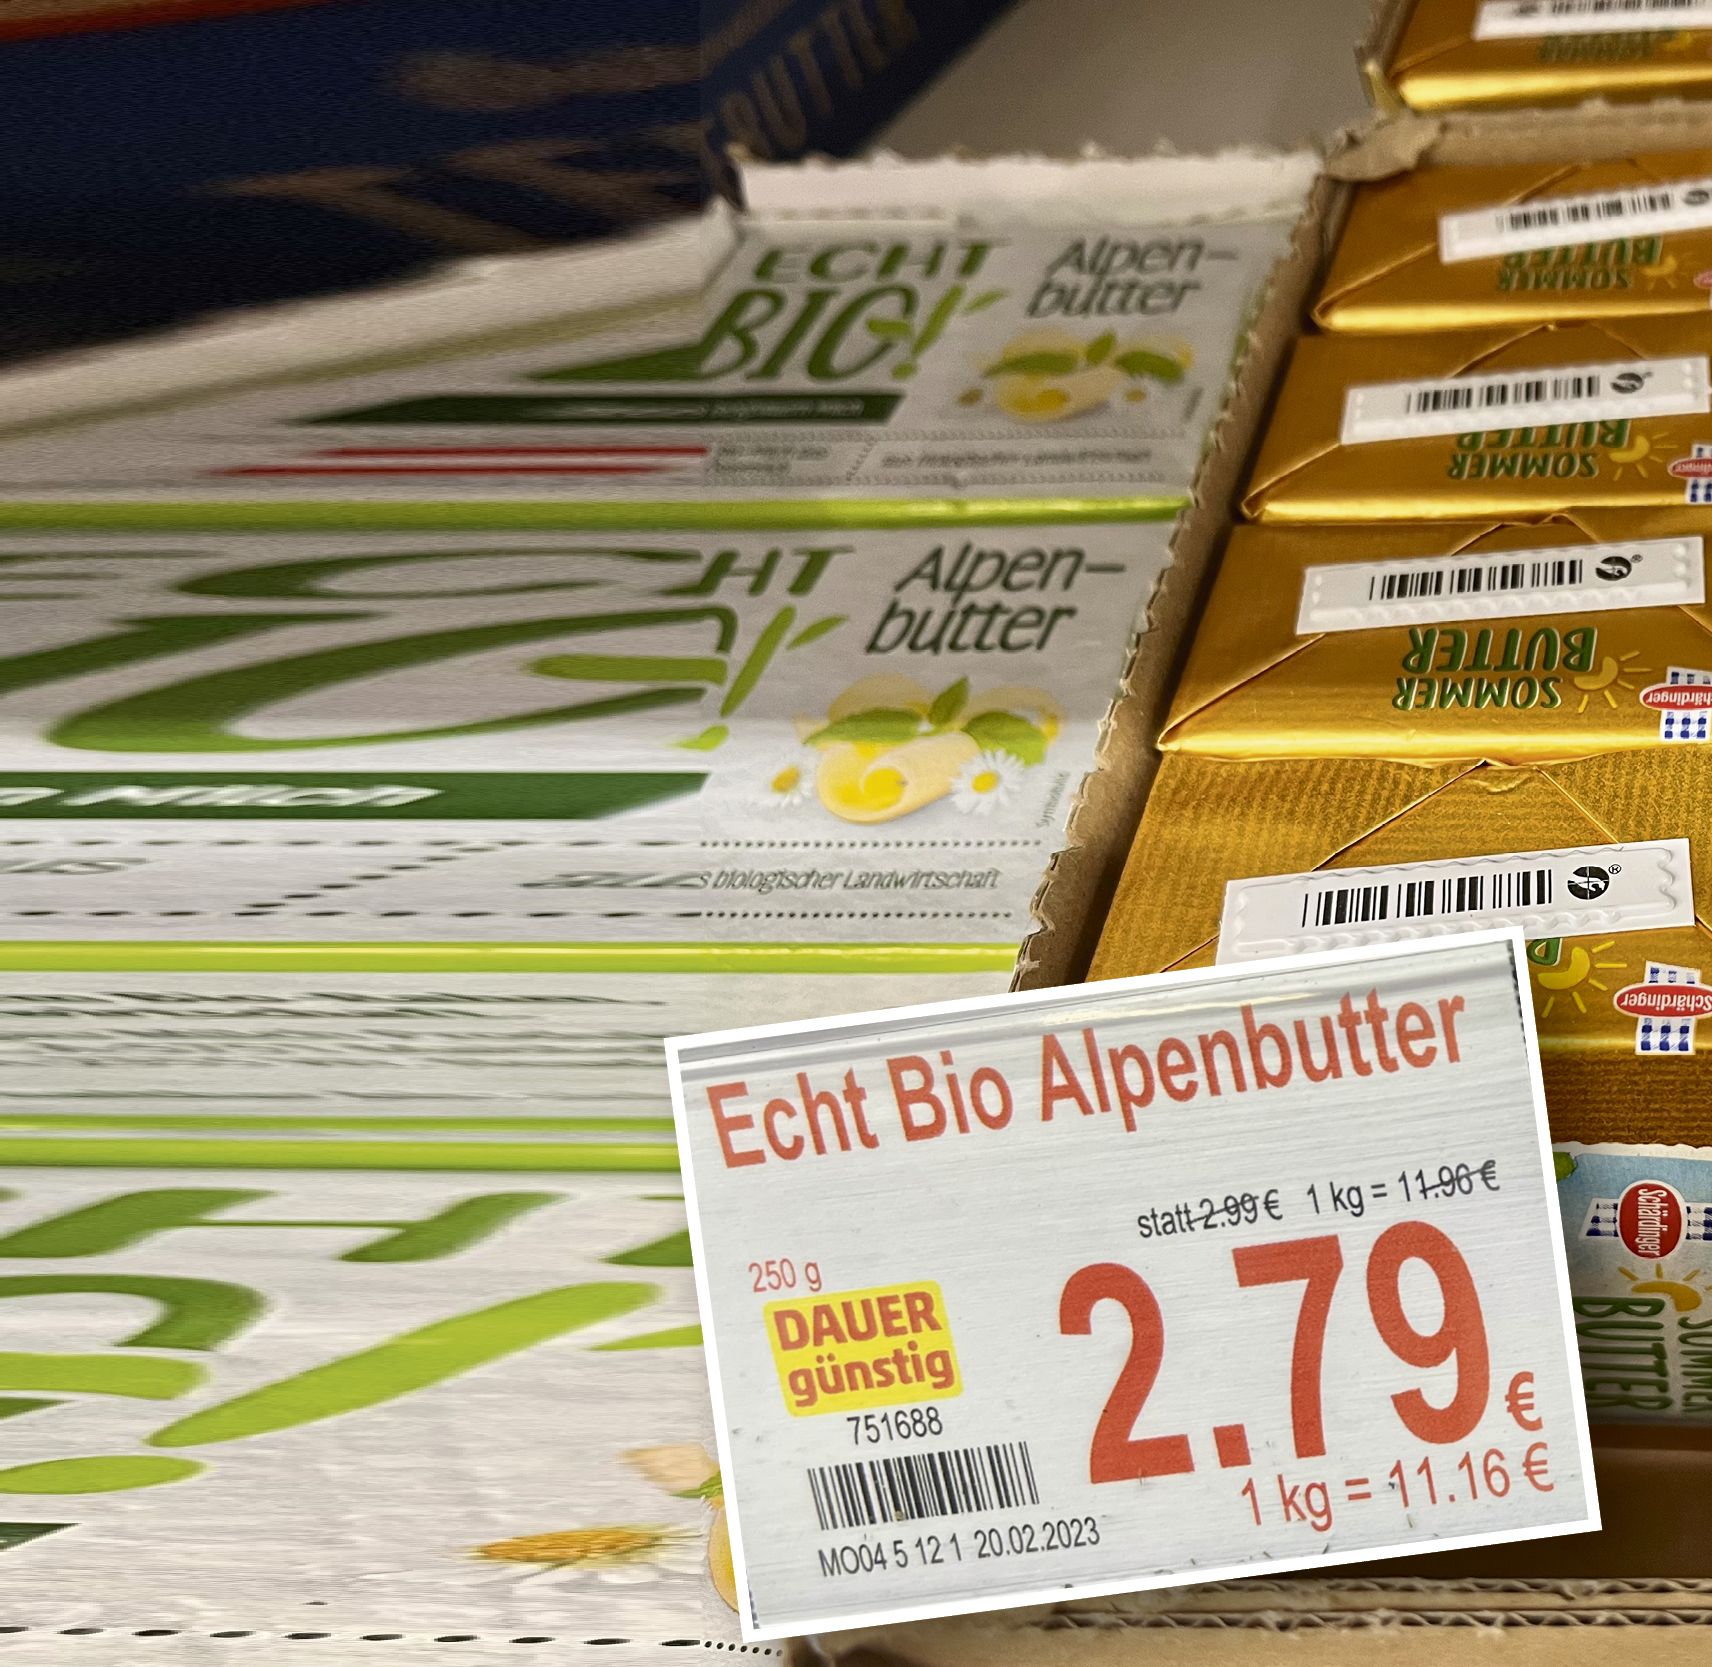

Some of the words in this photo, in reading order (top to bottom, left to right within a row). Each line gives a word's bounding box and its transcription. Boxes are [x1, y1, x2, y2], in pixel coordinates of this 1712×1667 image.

[755, 241, 1008, 281] ECHT
[1046, 236, 1238, 281] Alpen-
[1026, 275, 1202, 318] butter
[1449, 452, 1598, 480] SOMMER
[894, 541, 1126, 604] Alpen-
[865, 598, 1078, 656] butter
[1402, 627, 1598, 674] BUTTER
[1393, 677, 1562, 711] SOMMER
[712, 868, 843, 895] biologischer
[843, 868, 1002, 890] Landwirtschaft
[1620, 992, 1712, 1012] Schärdinger
[706, 1071, 879, 1169] Echt
[887, 1050, 1013, 1142] Bio
[1041, 991, 1465, 1133] Alpenbutter
[1137, 1201, 1196, 1239] statt
[1199, 1193, 1259, 1230] 2.99
[1263, 1189, 1284, 1221] €
[1306, 1183, 1321, 1215] 1
[1329, 1181, 1364, 1217] kg
[1370, 1183, 1388, 1199] =
[1398, 1164, 1475, 1203] 11.96
[1480, 1160, 1501, 1192] €
[1637, 1188, 1668, 1257] Schärdinger
[749, 1259, 799, 1294] 250
[804, 1260, 822, 1292] g
[774, 1291, 940, 1350] DAUER
[788, 1342, 954, 1407] günstig
[1058, 1220, 1492, 1485] 2.79
[1504, 1370, 1543, 1432] €
[1572, 1296, 1675, 1411] BUTTER
[846, 1406, 943, 1445] 751688
[1242, 1478, 1262, 1526] 1
[1277, 1475, 1333, 1533] kg
[1344, 1478, 1372, 1502] =
[1389, 1447, 1511, 1507] 11.16
[1522, 1442, 1554, 1492] €
[893, 1539, 908, 1568] 5
[915, 1535, 944, 1565] 12
[950, 1533, 963, 1561] 1
[974, 1516, 1100, 1559] 20.02.2023
